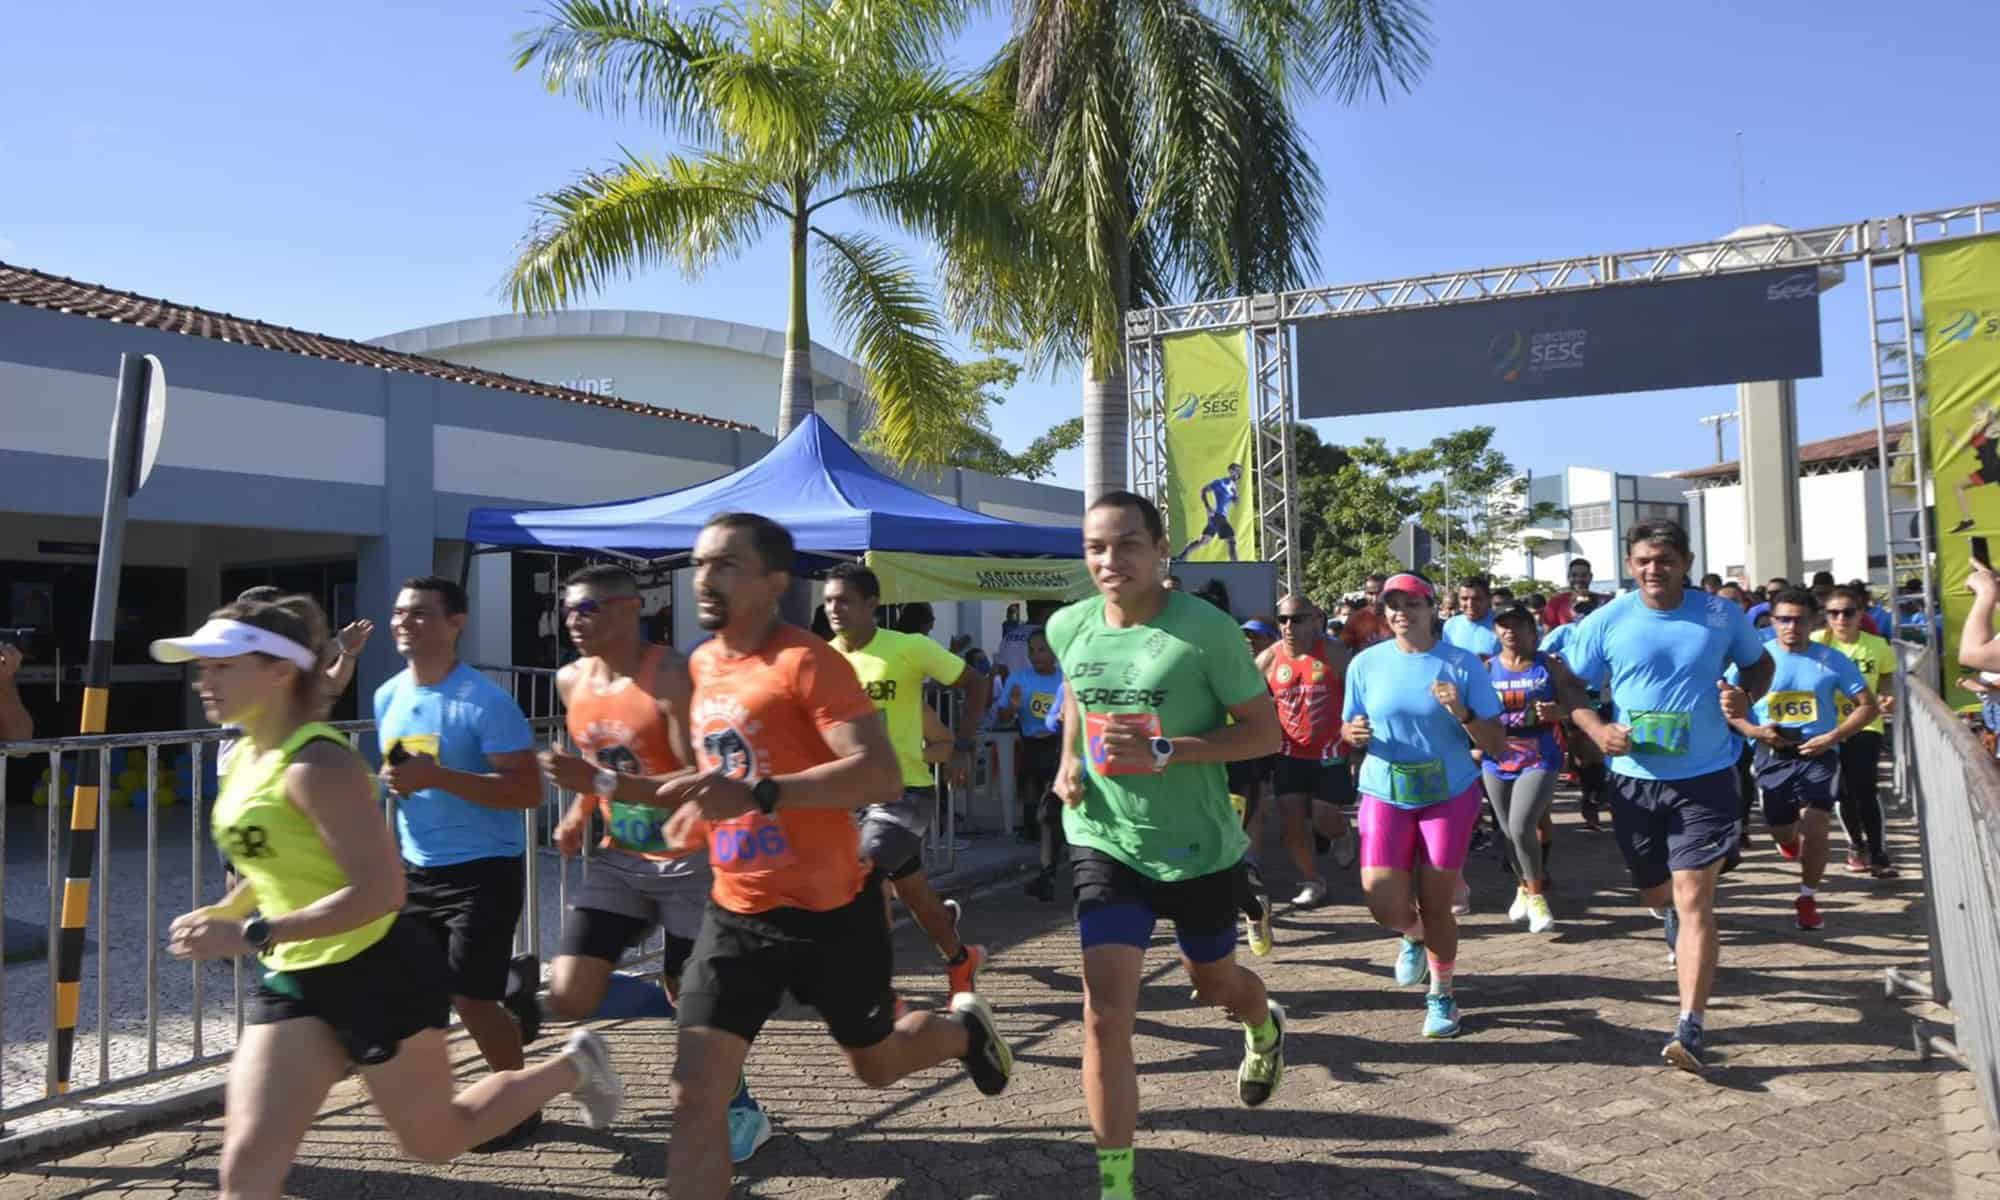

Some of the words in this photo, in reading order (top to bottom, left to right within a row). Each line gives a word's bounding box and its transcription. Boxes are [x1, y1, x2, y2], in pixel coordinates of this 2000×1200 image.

[1530, 342, 1585, 362] SESC
[556, 369, 615, 396] AÚDE
[1202, 399, 1239, 414] SESC
[1772, 701, 1813, 717] 166
[716, 824, 785, 862] 006
